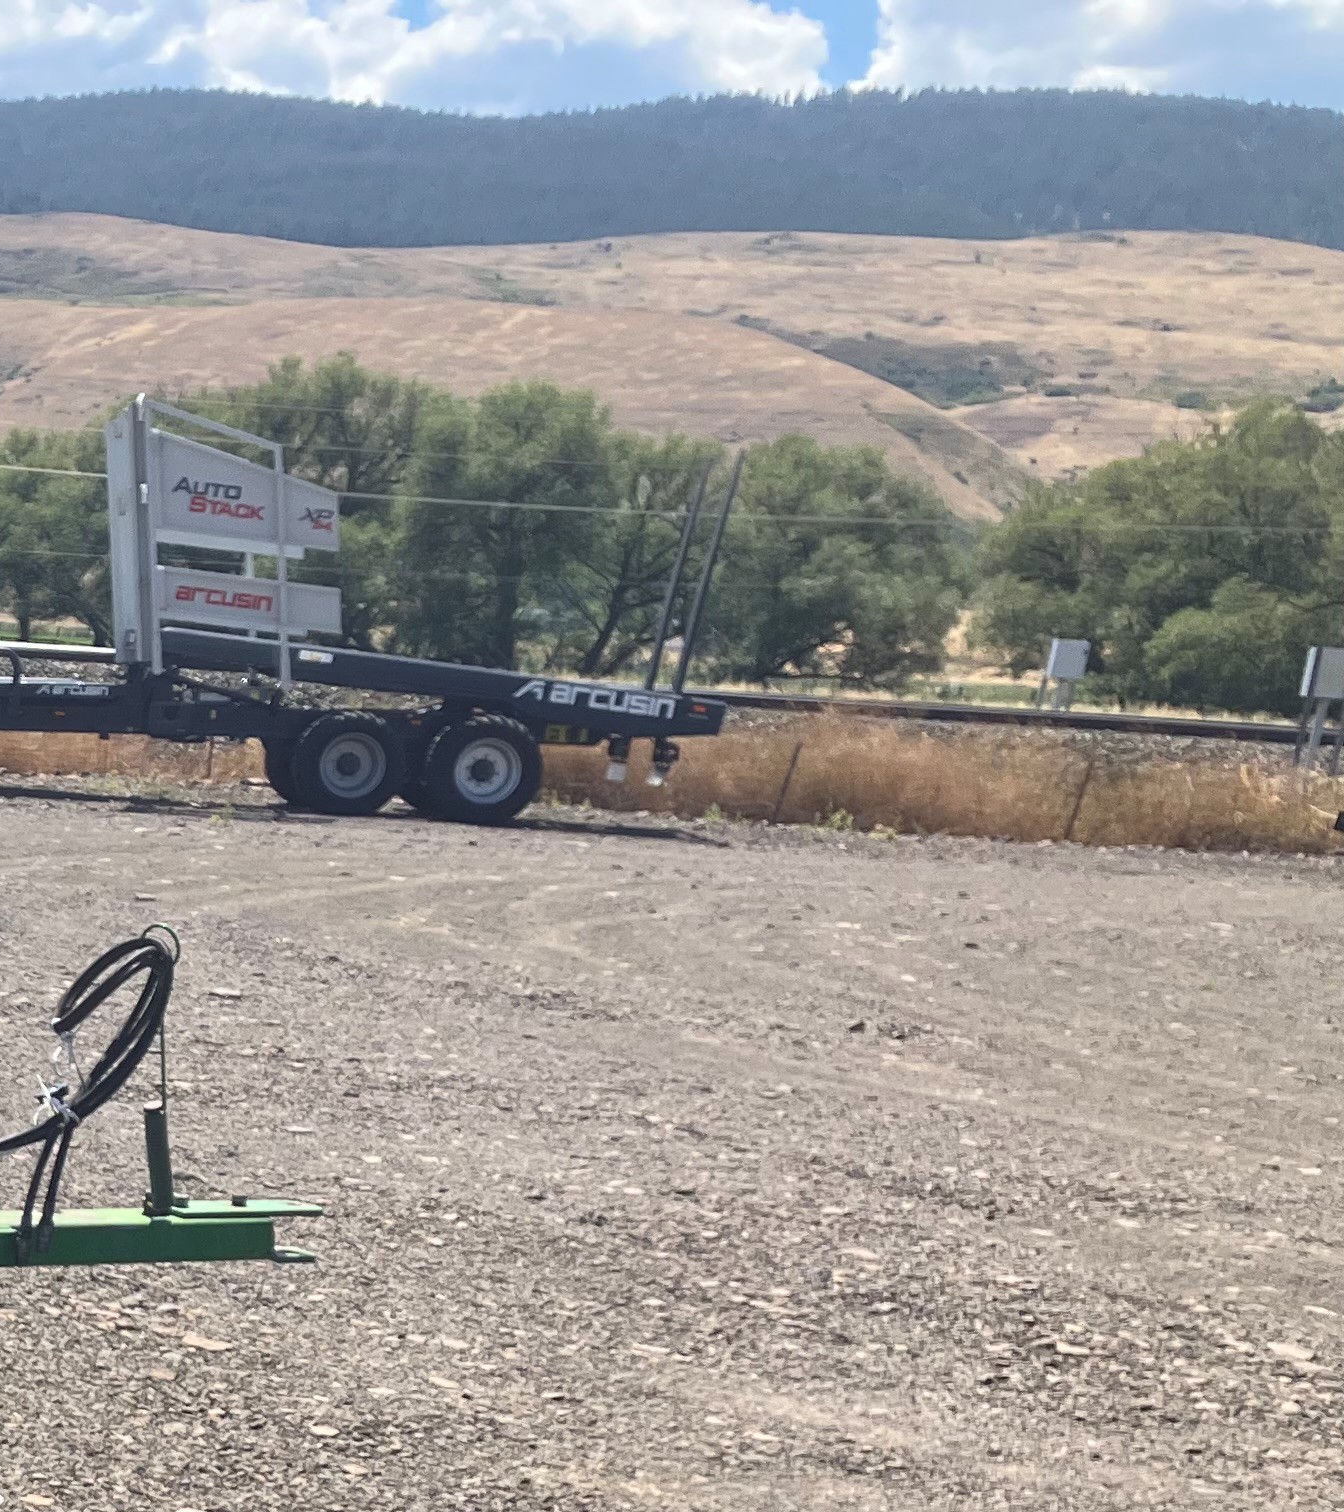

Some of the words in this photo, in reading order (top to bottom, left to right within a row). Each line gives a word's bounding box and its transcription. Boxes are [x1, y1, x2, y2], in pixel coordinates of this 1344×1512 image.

[171, 475, 243, 500] AUTO
[189, 496, 265, 521] STACK
[175, 585, 273, 611] arcusin
[549, 683, 677, 720] arcusin
